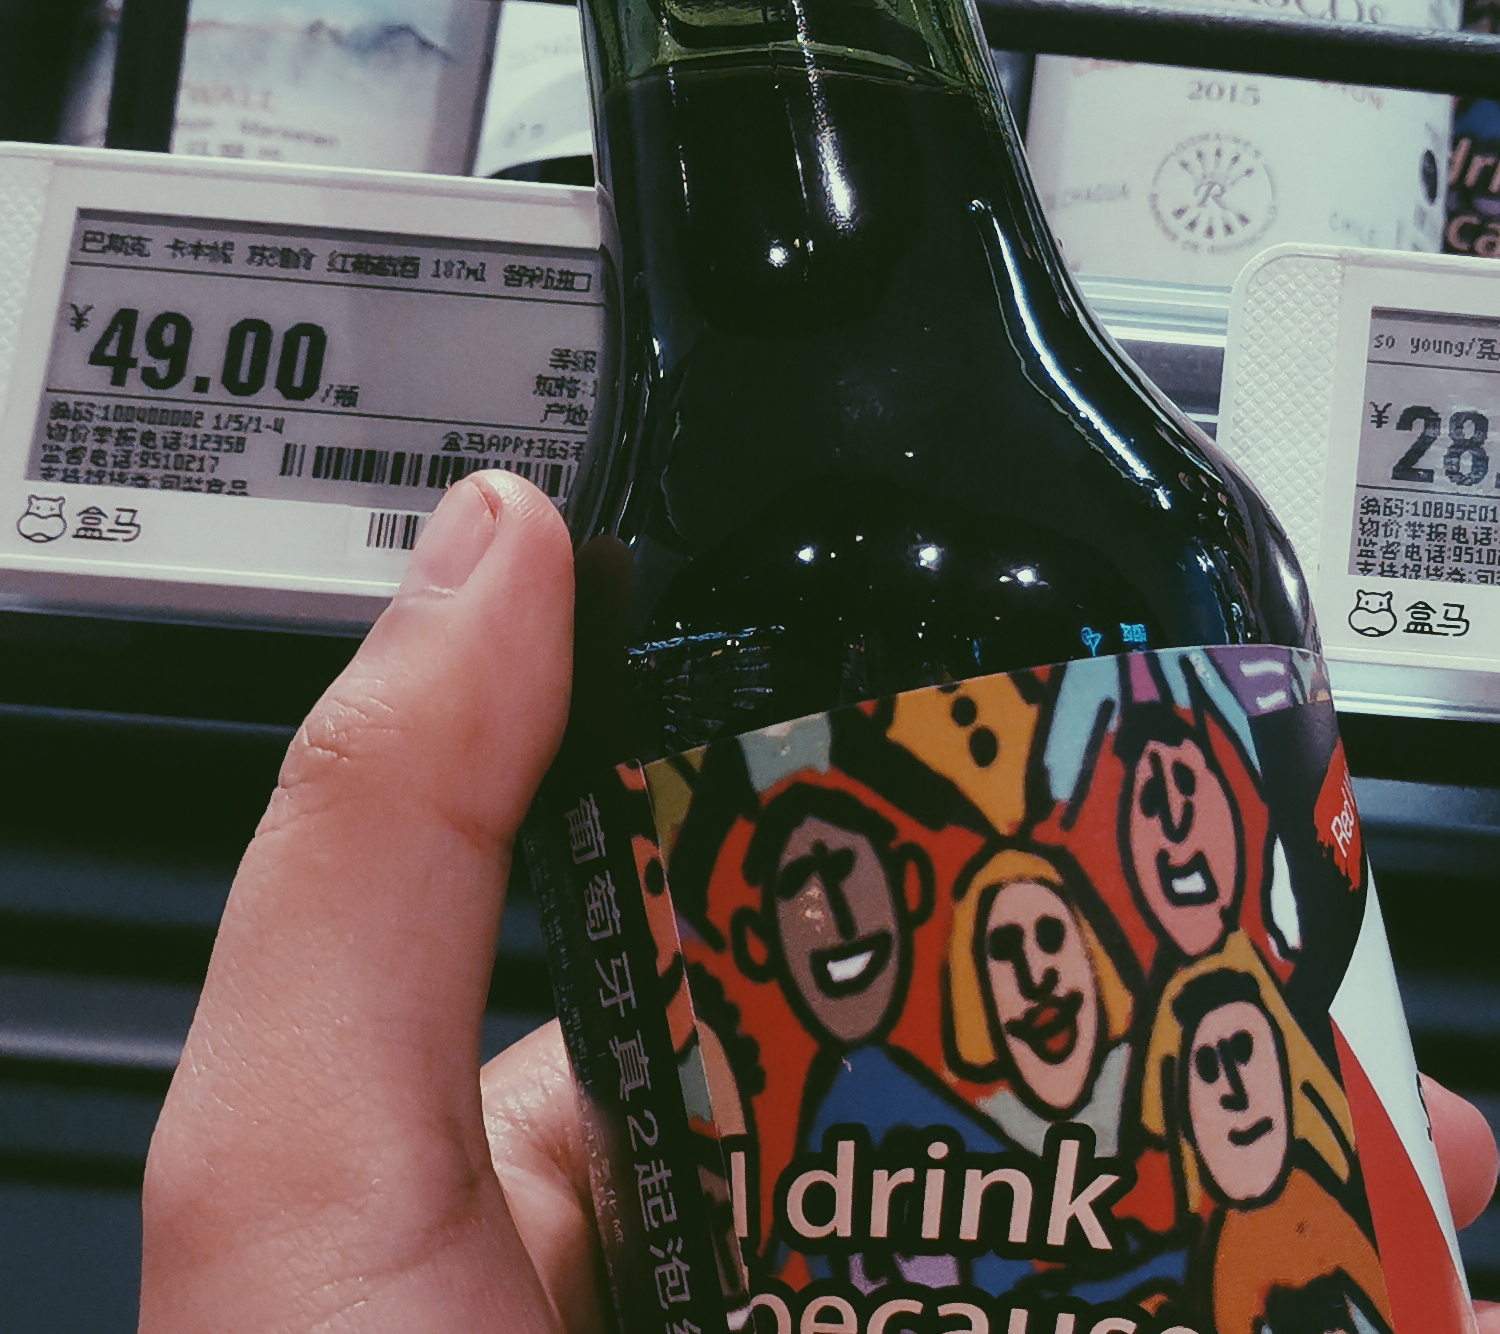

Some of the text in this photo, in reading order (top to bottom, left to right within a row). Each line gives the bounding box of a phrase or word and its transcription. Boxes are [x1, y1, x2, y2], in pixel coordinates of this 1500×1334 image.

[1187, 80, 1262, 107] 2015
[71, 505, 142, 543] 盒马
[1403, 599, 1470, 638] 盒马
[786, 1138, 1121, 1251] drink
